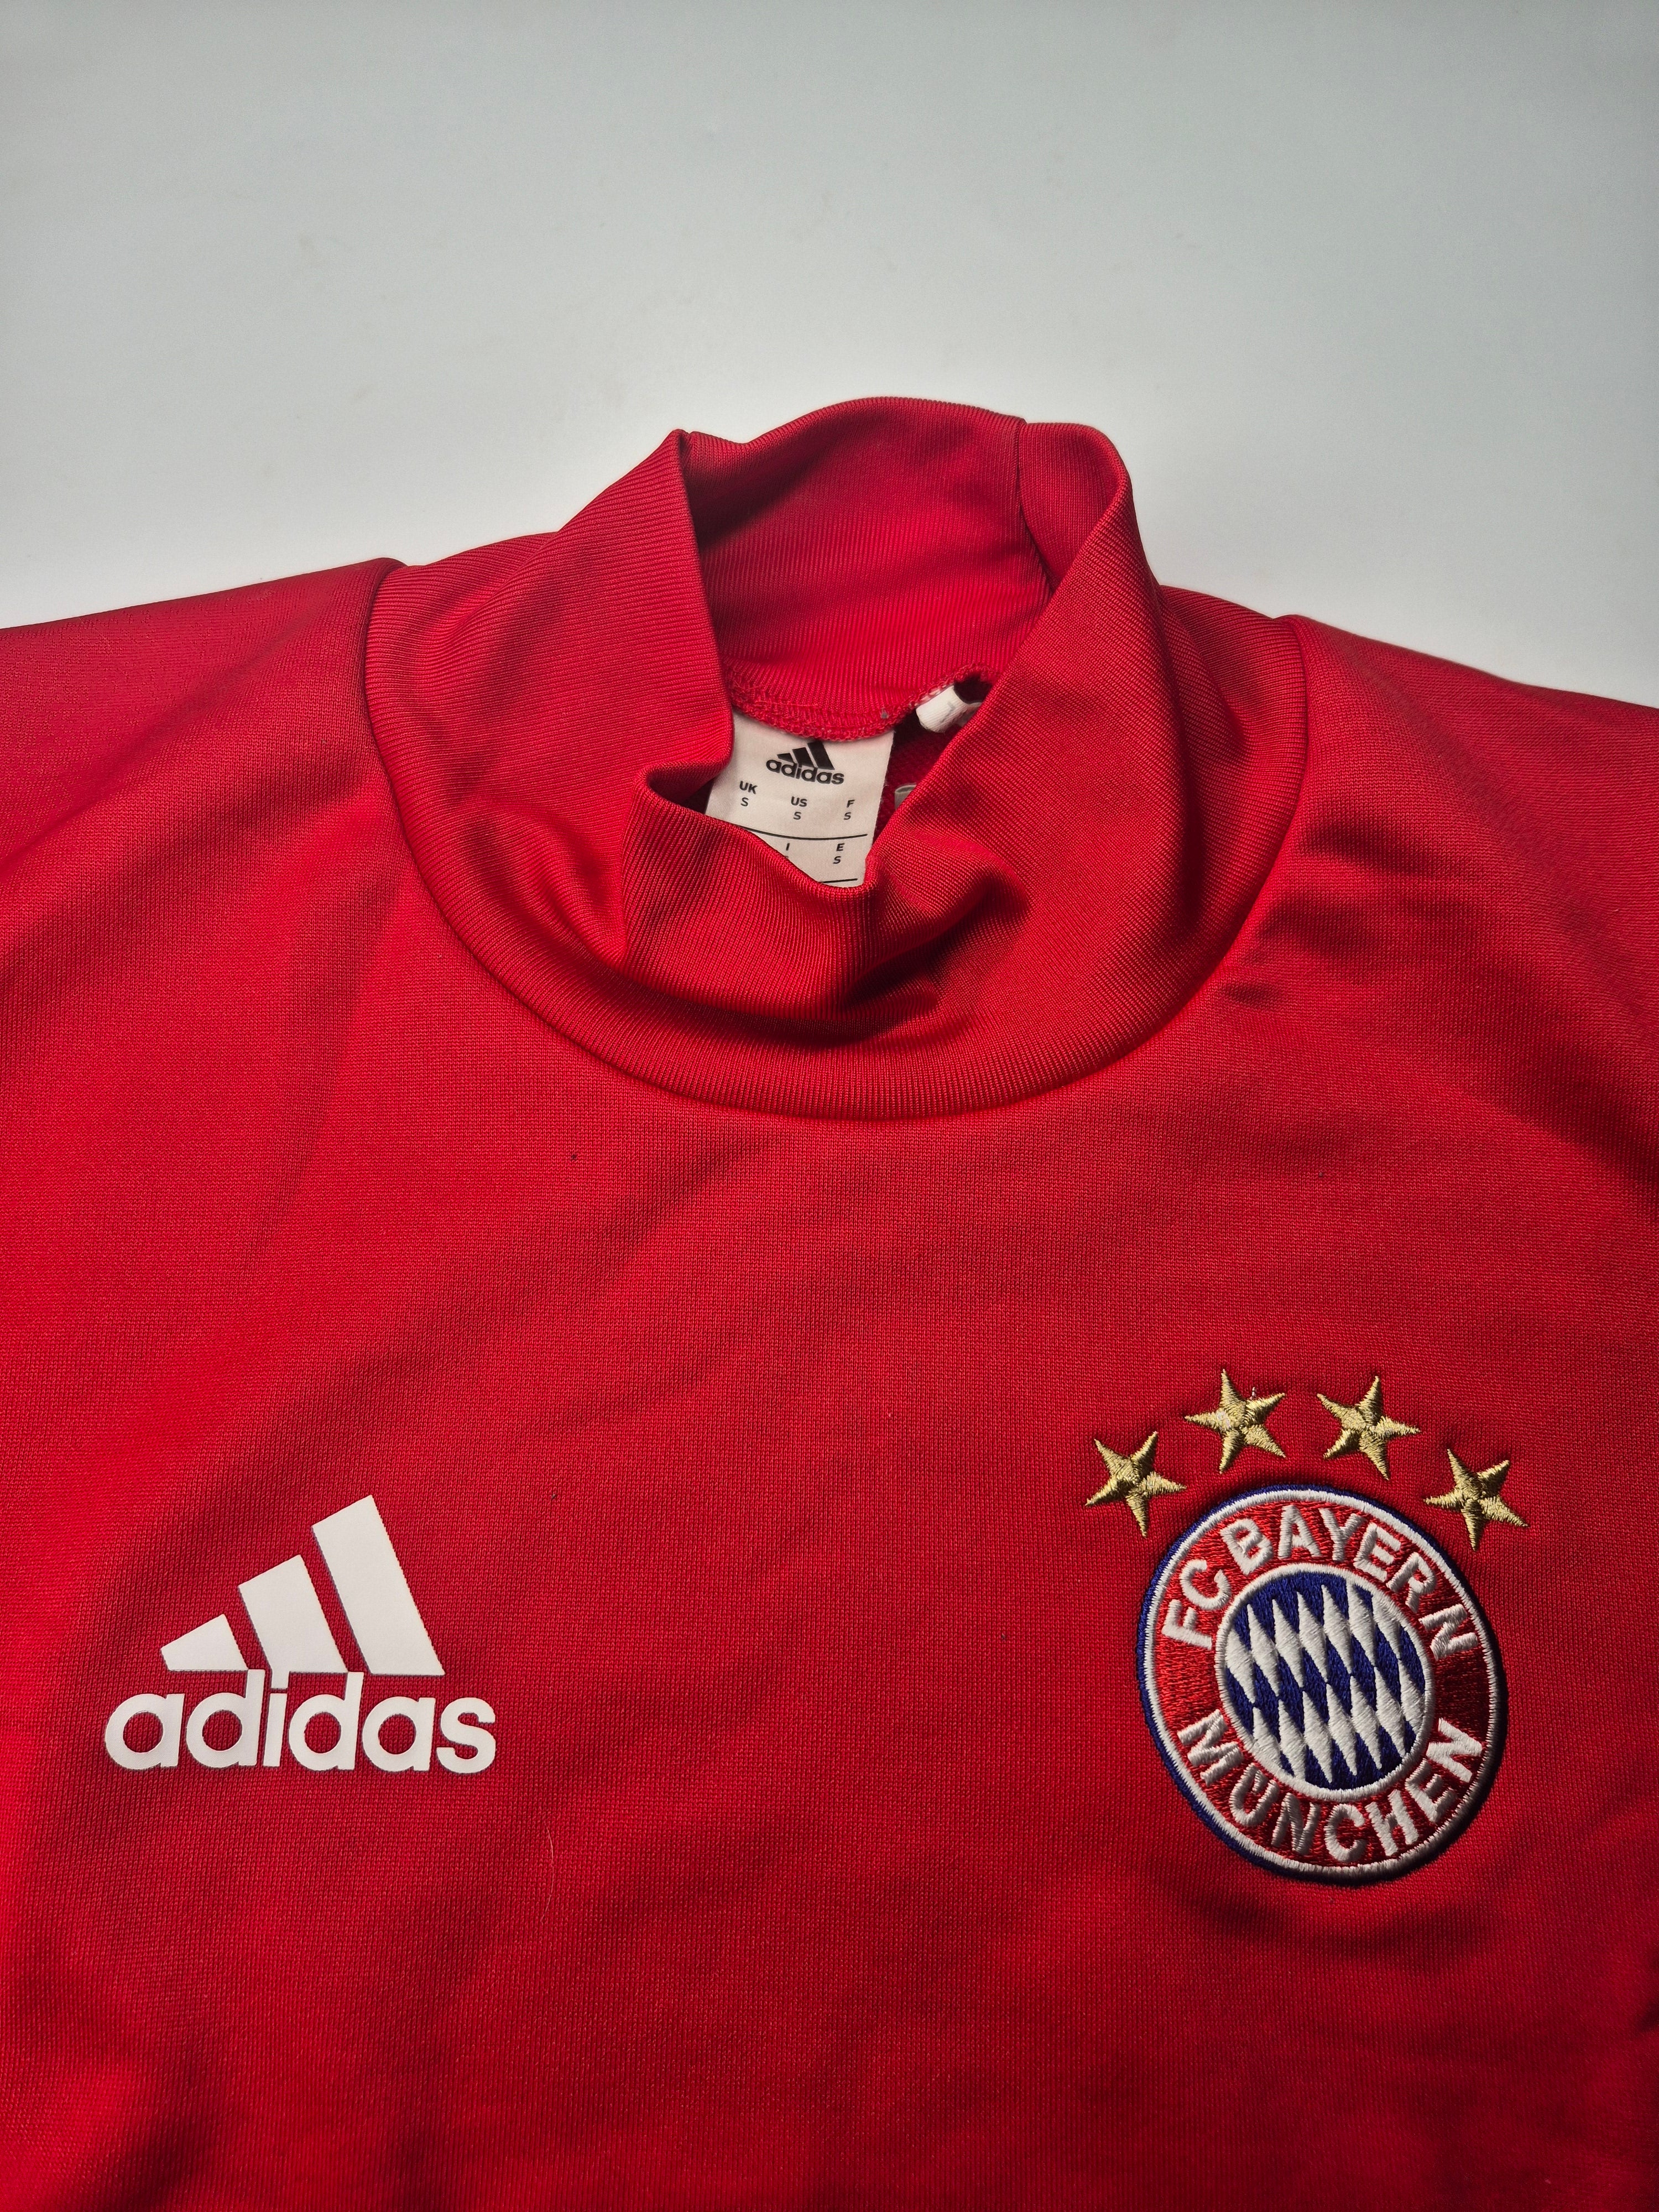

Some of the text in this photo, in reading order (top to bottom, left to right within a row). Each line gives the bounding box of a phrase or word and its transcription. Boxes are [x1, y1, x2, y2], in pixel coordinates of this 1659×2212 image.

[766, 759, 844, 785] adidas
[739, 780, 758, 795] UK
[740, 797, 749, 807] S
[790, 796, 807, 807] US
[846, 799, 855, 808] F
[793, 811, 802, 820] S
[843, 812, 852, 820] S
[786, 843, 790, 851] I
[836, 843, 845, 852] E
[832, 855, 842, 864] S
[1162, 1504, 1478, 1660] FC BAYERN
[105, 1669, 496, 1773] adidas
